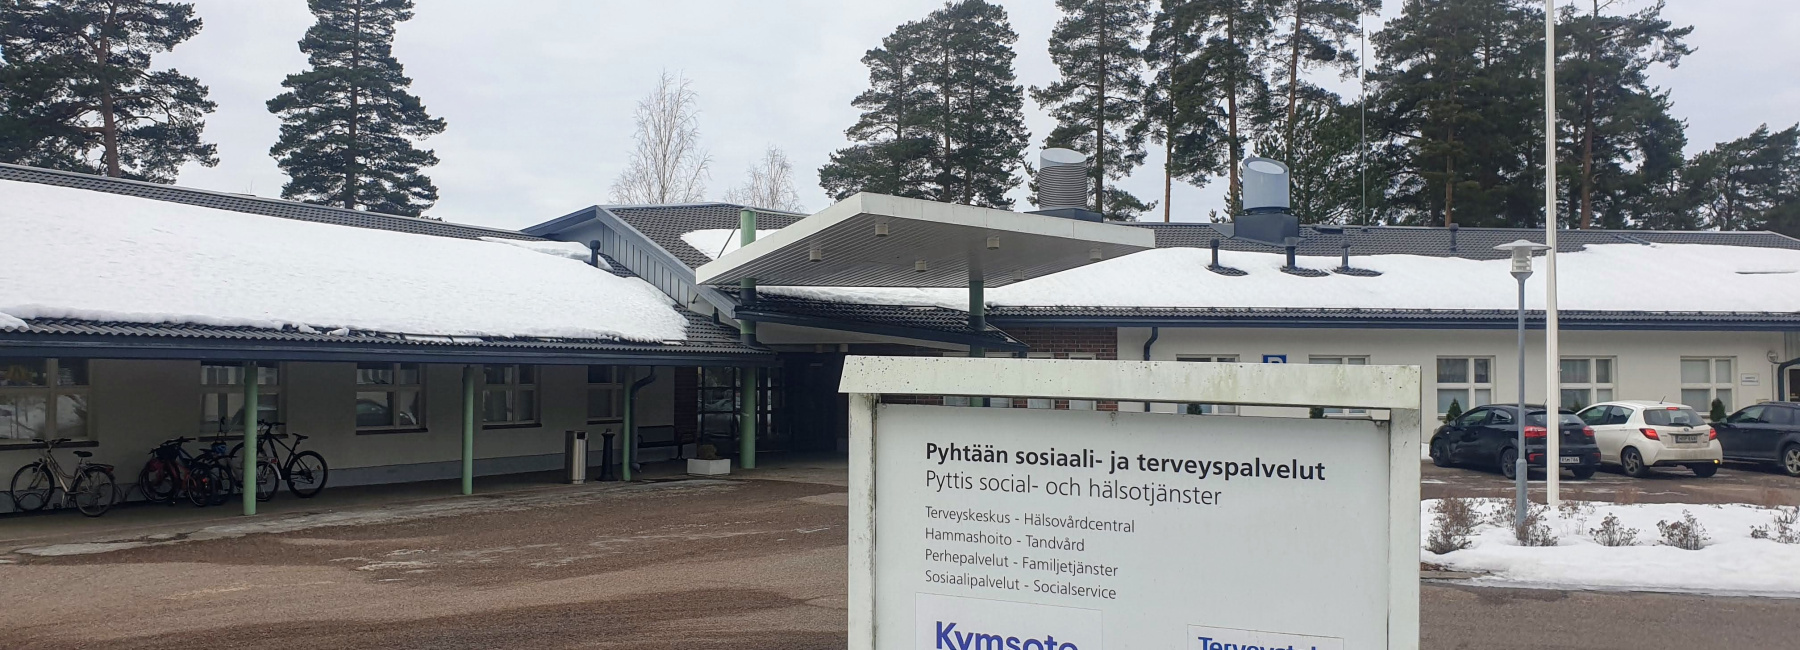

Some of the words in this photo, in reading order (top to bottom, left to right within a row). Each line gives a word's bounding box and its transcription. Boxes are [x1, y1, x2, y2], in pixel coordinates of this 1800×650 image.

[926, 442, 1009, 466] Pyhtään
[1015, 447, 1103, 469] sosiaali-
[1108, 450, 1130, 475] ja
[1136, 453, 1326, 481] terveyspalvelut
[926, 469, 973, 493] Pyttis
[979, 473, 1039, 494] social-
[1045, 476, 1081, 498] och
[1089, 477, 1223, 507] hälsotjänster
[925, 505, 1011, 524] Terveyskeskus
[1024, 512, 1135, 533] Hälsovårdcentral
[925, 527, 1013, 546] Hammashoito
[1025, 535, 1085, 552] Tandvård
[925, 548, 1010, 568] Perhepalvelut
[1022, 556, 1119, 577] Familjetjänster
[925, 569, 1020, 590] Sosiaalipalvelut
[1033, 579, 1117, 600] Socialservice
